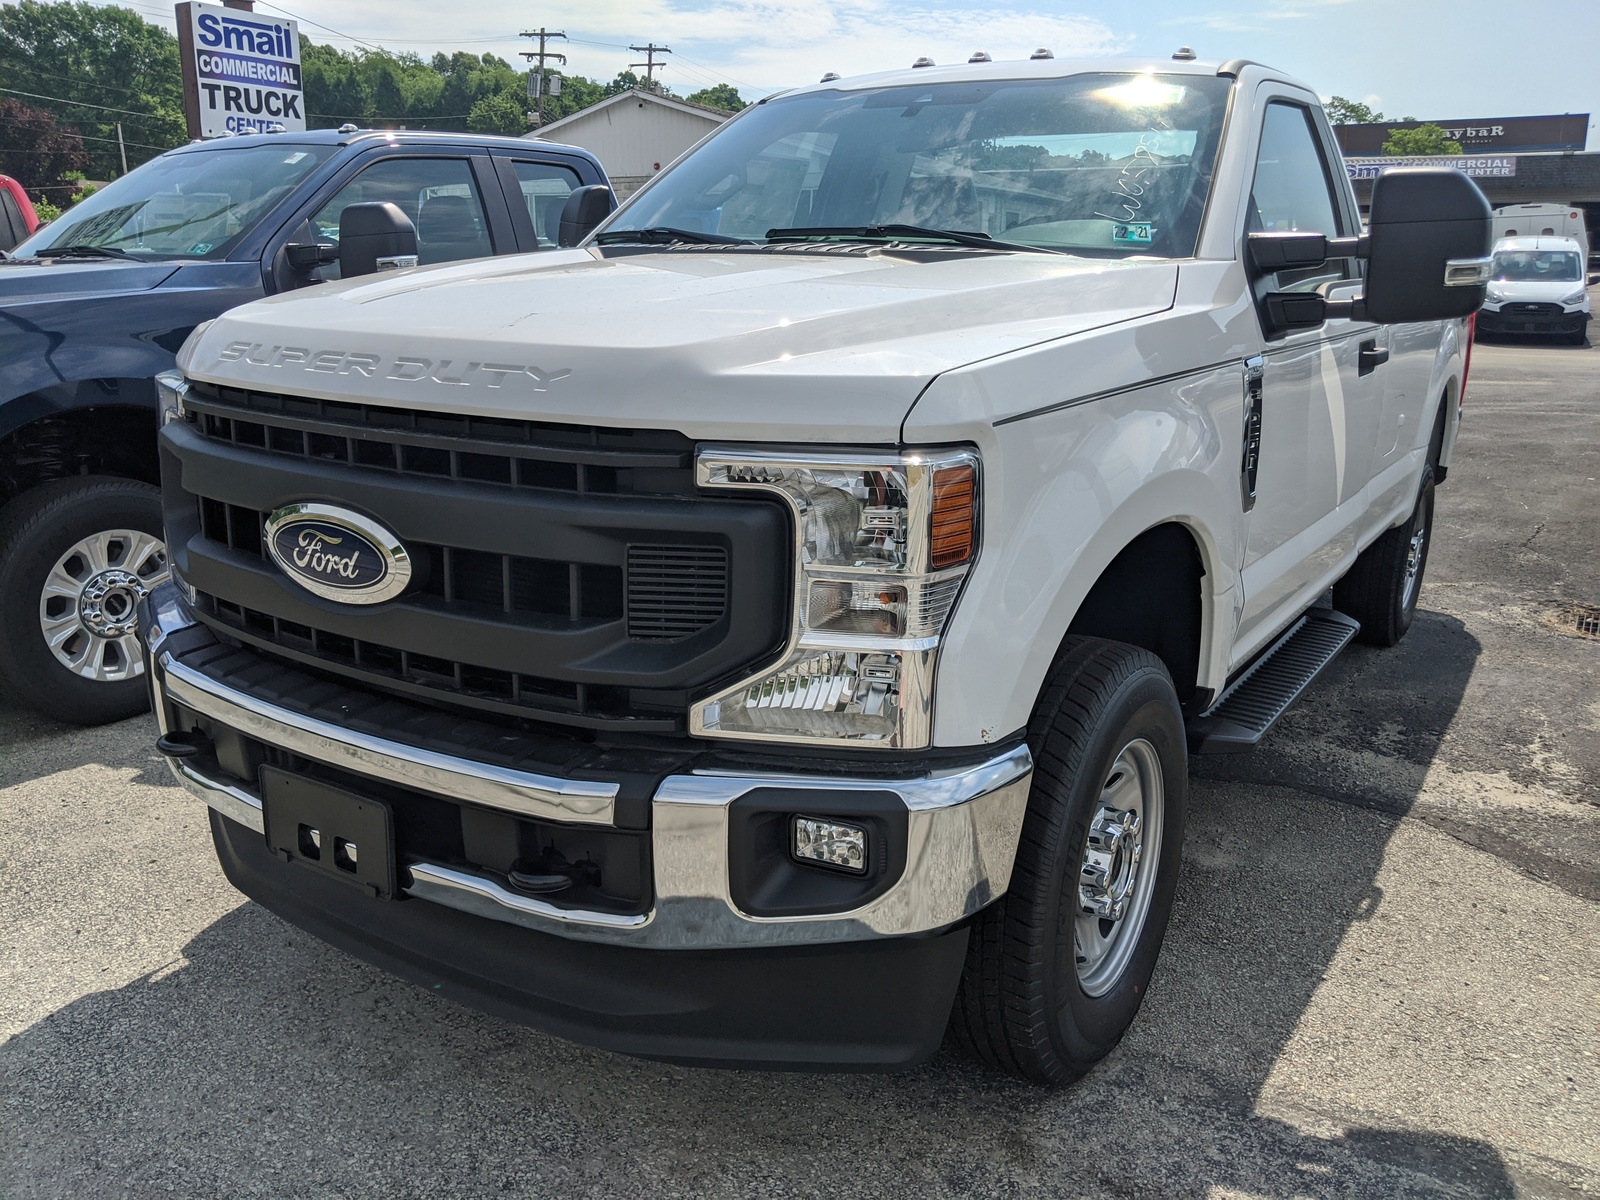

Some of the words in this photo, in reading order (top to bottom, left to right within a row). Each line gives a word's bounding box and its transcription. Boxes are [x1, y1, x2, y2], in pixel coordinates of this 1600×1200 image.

[197, 13, 292, 59] Smail
[199, 55, 298, 85] COMMERCIAL
[201, 82, 302, 120] TRUCK
[218, 341, 382, 377] SUPER
[386, 357, 572, 392] DUTY
[293, 528, 360, 580] Ford
